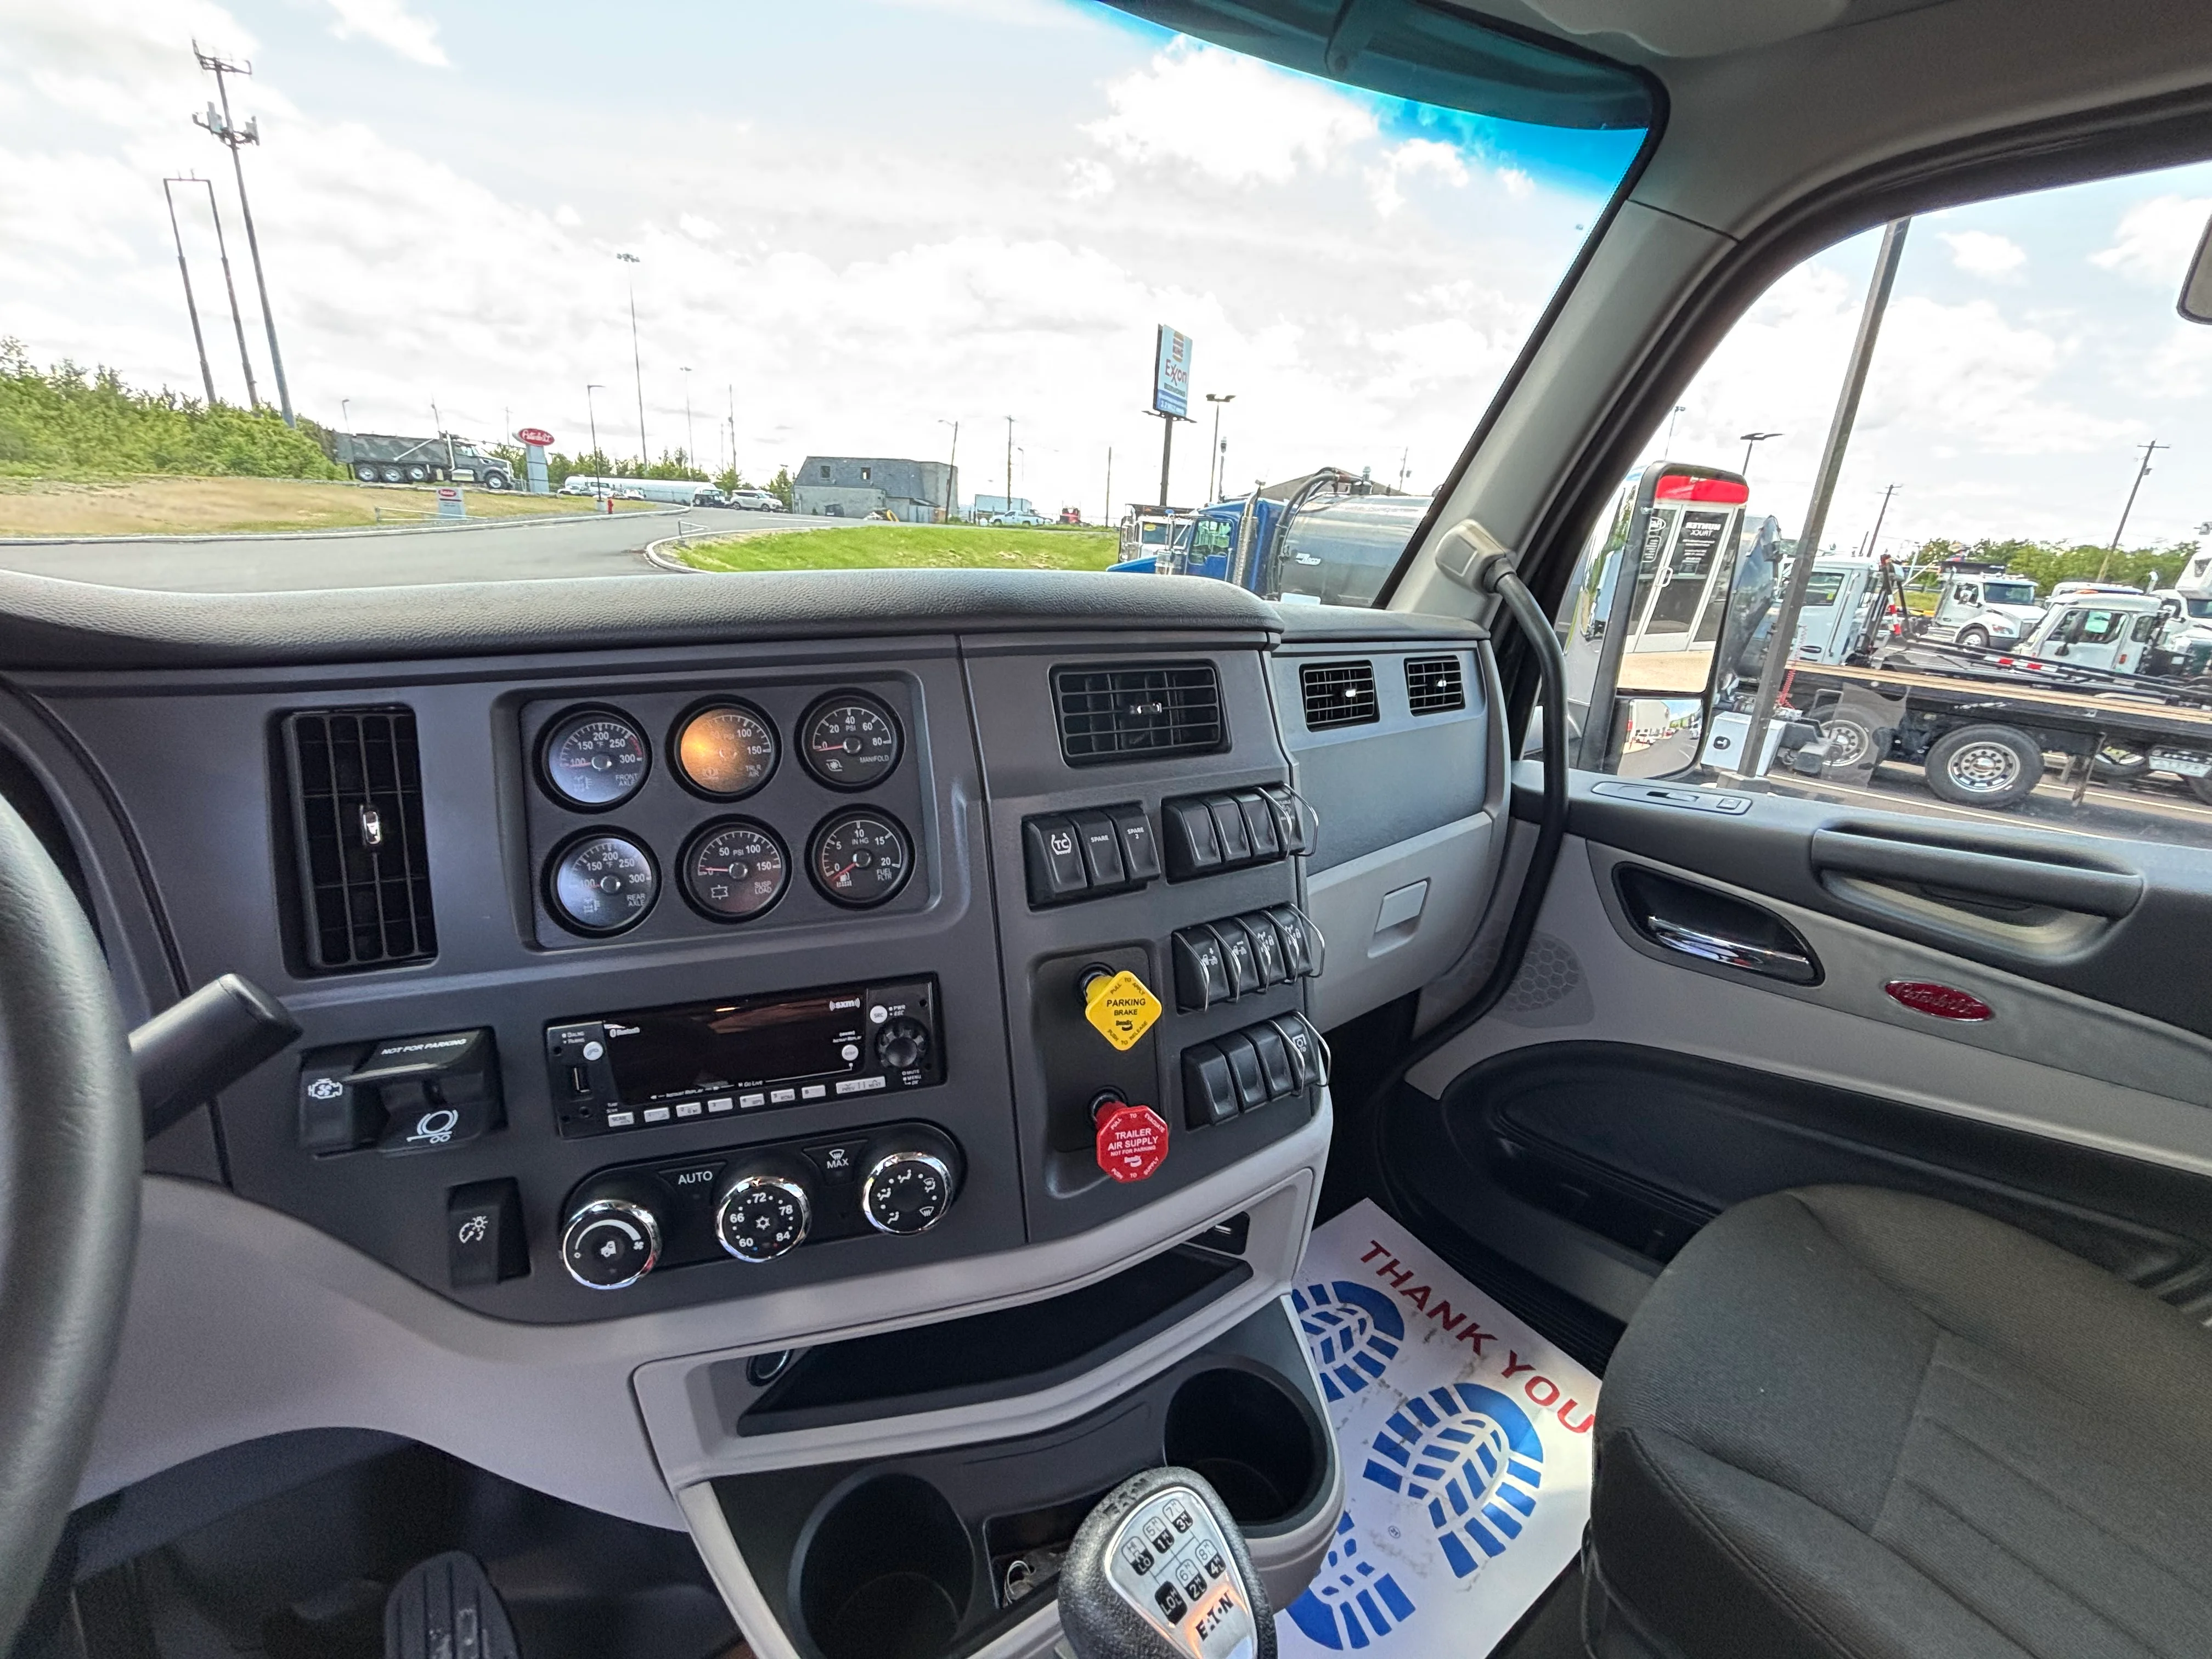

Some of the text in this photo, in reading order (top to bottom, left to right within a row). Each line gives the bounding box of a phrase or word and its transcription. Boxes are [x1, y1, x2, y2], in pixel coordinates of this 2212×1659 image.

[1165, 359, 1187, 386] Exxon
[863, 723, 873, 731] 60
[593, 732, 609, 741] 200
[737, 729, 752, 737] 100
[578, 741, 592, 750] 150
[610, 739, 625, 748] 250
[872, 737, 882, 746] 80
[747, 746, 761, 754] 150
[619, 754, 635, 763] 300
[860, 755, 889, 763] MANIFOLD
[855, 830, 864, 838] 10
[836, 842, 842, 850] 5
[874, 837, 885, 845] 15
[1054, 839, 1069, 850] TC
[719, 847, 729, 856] 50
[746, 845, 760, 854] 100
[602, 852, 618, 861] 200
[881, 857, 890, 866] 20
[587, 862, 602, 871] 150
[619, 860, 635, 868] 250
[757, 861, 771, 871] 150
[580, 879, 595, 887] 100
[629, 874, 645, 883] 300
[1110, 983, 1122, 994] PULL
[1132, 983, 1146, 995] APPLY
[1107, 998, 1146, 1007] PARKING
[1108, 1029, 1119, 1041] PUSH
[1129, 1020, 1148, 1040] RELEASE
[425, 1039, 466, 1049] PARKING
[1110, 1118, 1122, 1130] PULL
[1115, 1128, 1152, 1140] TRAILER
[1108, 1136, 1159, 1151] AIR SUPPLY
[827, 1159, 849, 1169] MAX
[678, 1171, 713, 1185] AUTO
[753, 1193, 766, 1203] 72
[779, 1205, 793, 1216] 78
[730, 1214, 744, 1223] 66
[776, 1232, 791, 1242] 84
[739, 1238, 753, 1247] 60
[1361, 1239, 1595, 1434] THANK YOU
[1165, 1506, 1173, 1517] 7
[1176, 1519, 1186, 1530] 3
[1146, 1525, 1156, 1536] 5
[1158, 1539, 1166, 1549] 1
[1199, 1549, 1208, 1560] 8
[1138, 1557, 1151, 1572] LO
[1211, 1562, 1219, 1574] 4
[1180, 1570, 1188, 1581] 6
[1189, 1584, 1200, 1598] 2
[1160, 1596, 1176, 1615] LO
